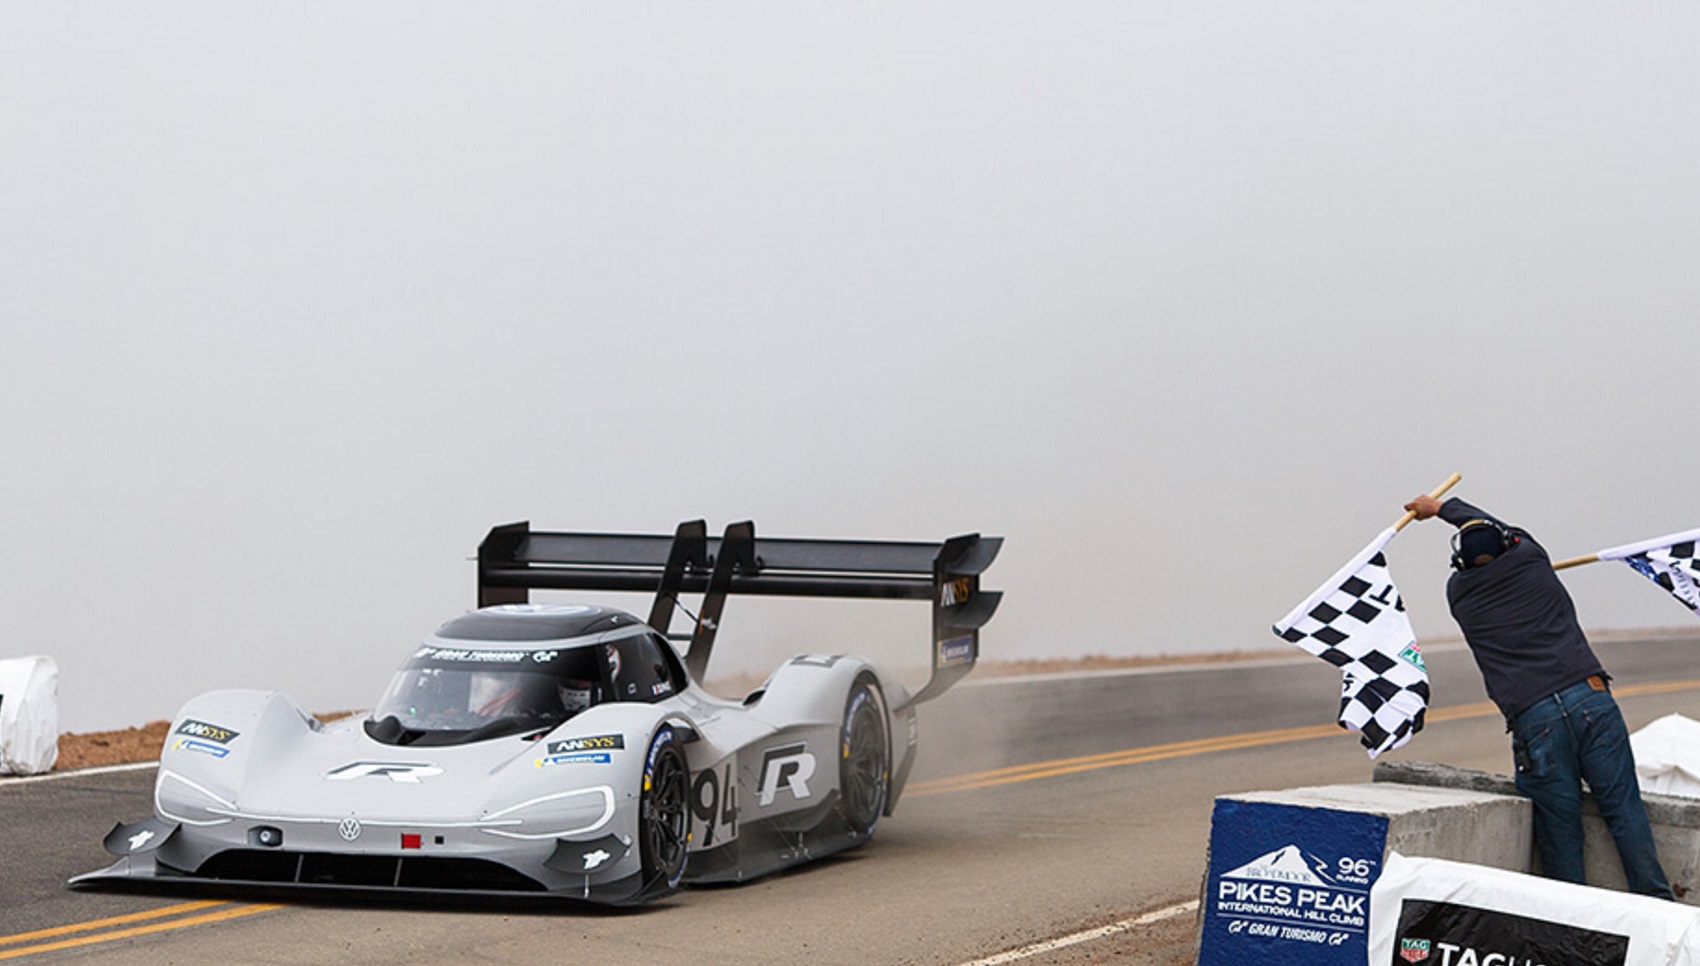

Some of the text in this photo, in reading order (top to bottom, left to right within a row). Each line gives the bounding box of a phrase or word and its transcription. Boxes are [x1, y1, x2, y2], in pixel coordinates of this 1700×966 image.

[181, 723, 231, 740] ANSYS
[557, 737, 614, 751] ANSYS
[757, 741, 816, 806] R
[691, 763, 740, 847] 94
[1219, 881, 1366, 915] PIKES PEAK
[1218, 901, 1364, 927] INTERNATIONAL HILL CLIMB
[1248, 922, 1280, 938] GRAN
[1280, 927, 1327, 944] TURISMO
[1404, 938, 1429, 950] TAG
